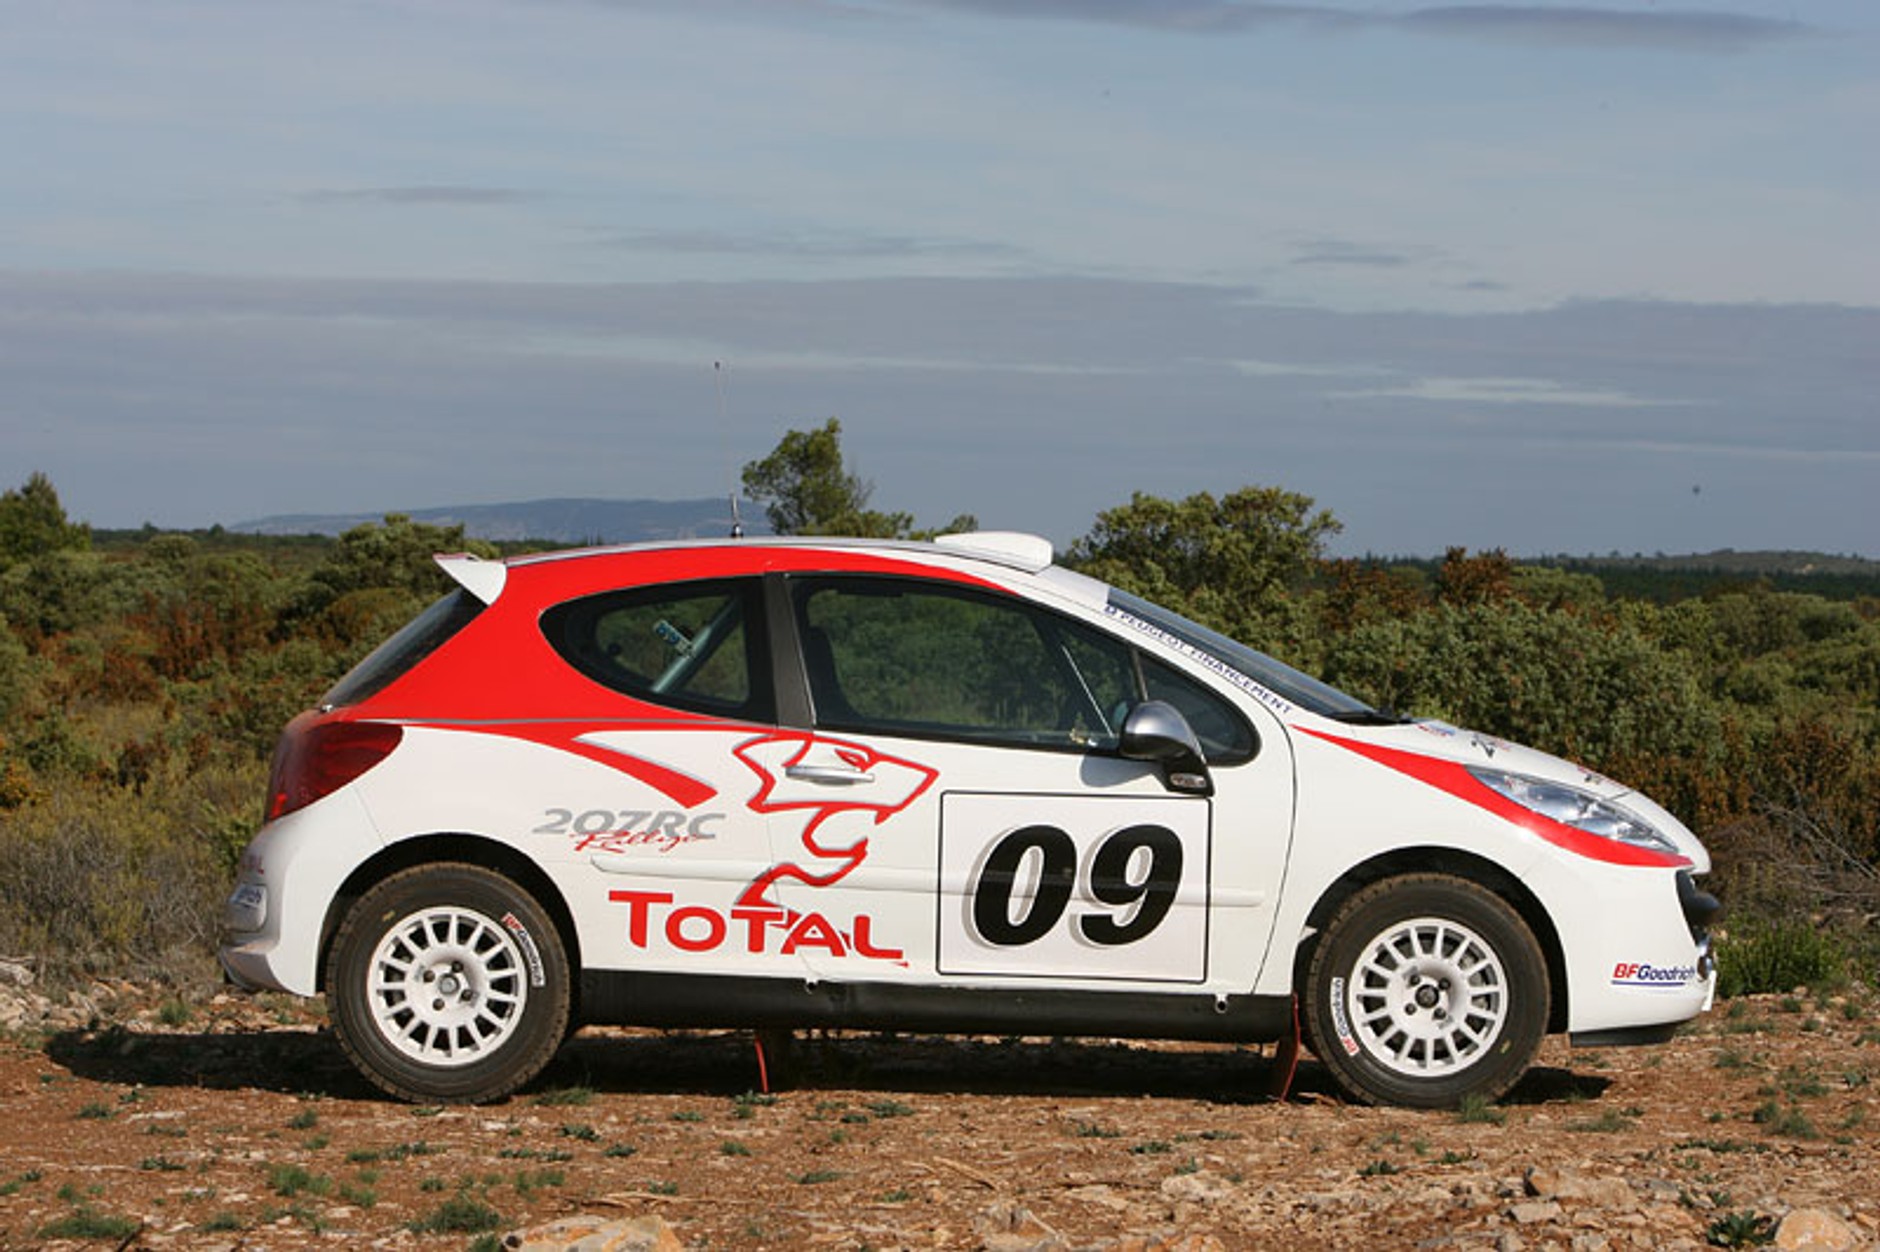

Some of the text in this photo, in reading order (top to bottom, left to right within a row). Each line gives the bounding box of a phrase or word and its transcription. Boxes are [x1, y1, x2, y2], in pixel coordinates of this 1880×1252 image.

[1119, 612, 1293, 714] PEUGEOT FINANCEMENT
[532, 808, 726, 839] 207RC
[964, 824, 1184, 949] 09
[1613, 963, 1696, 980] BFGoodrich
